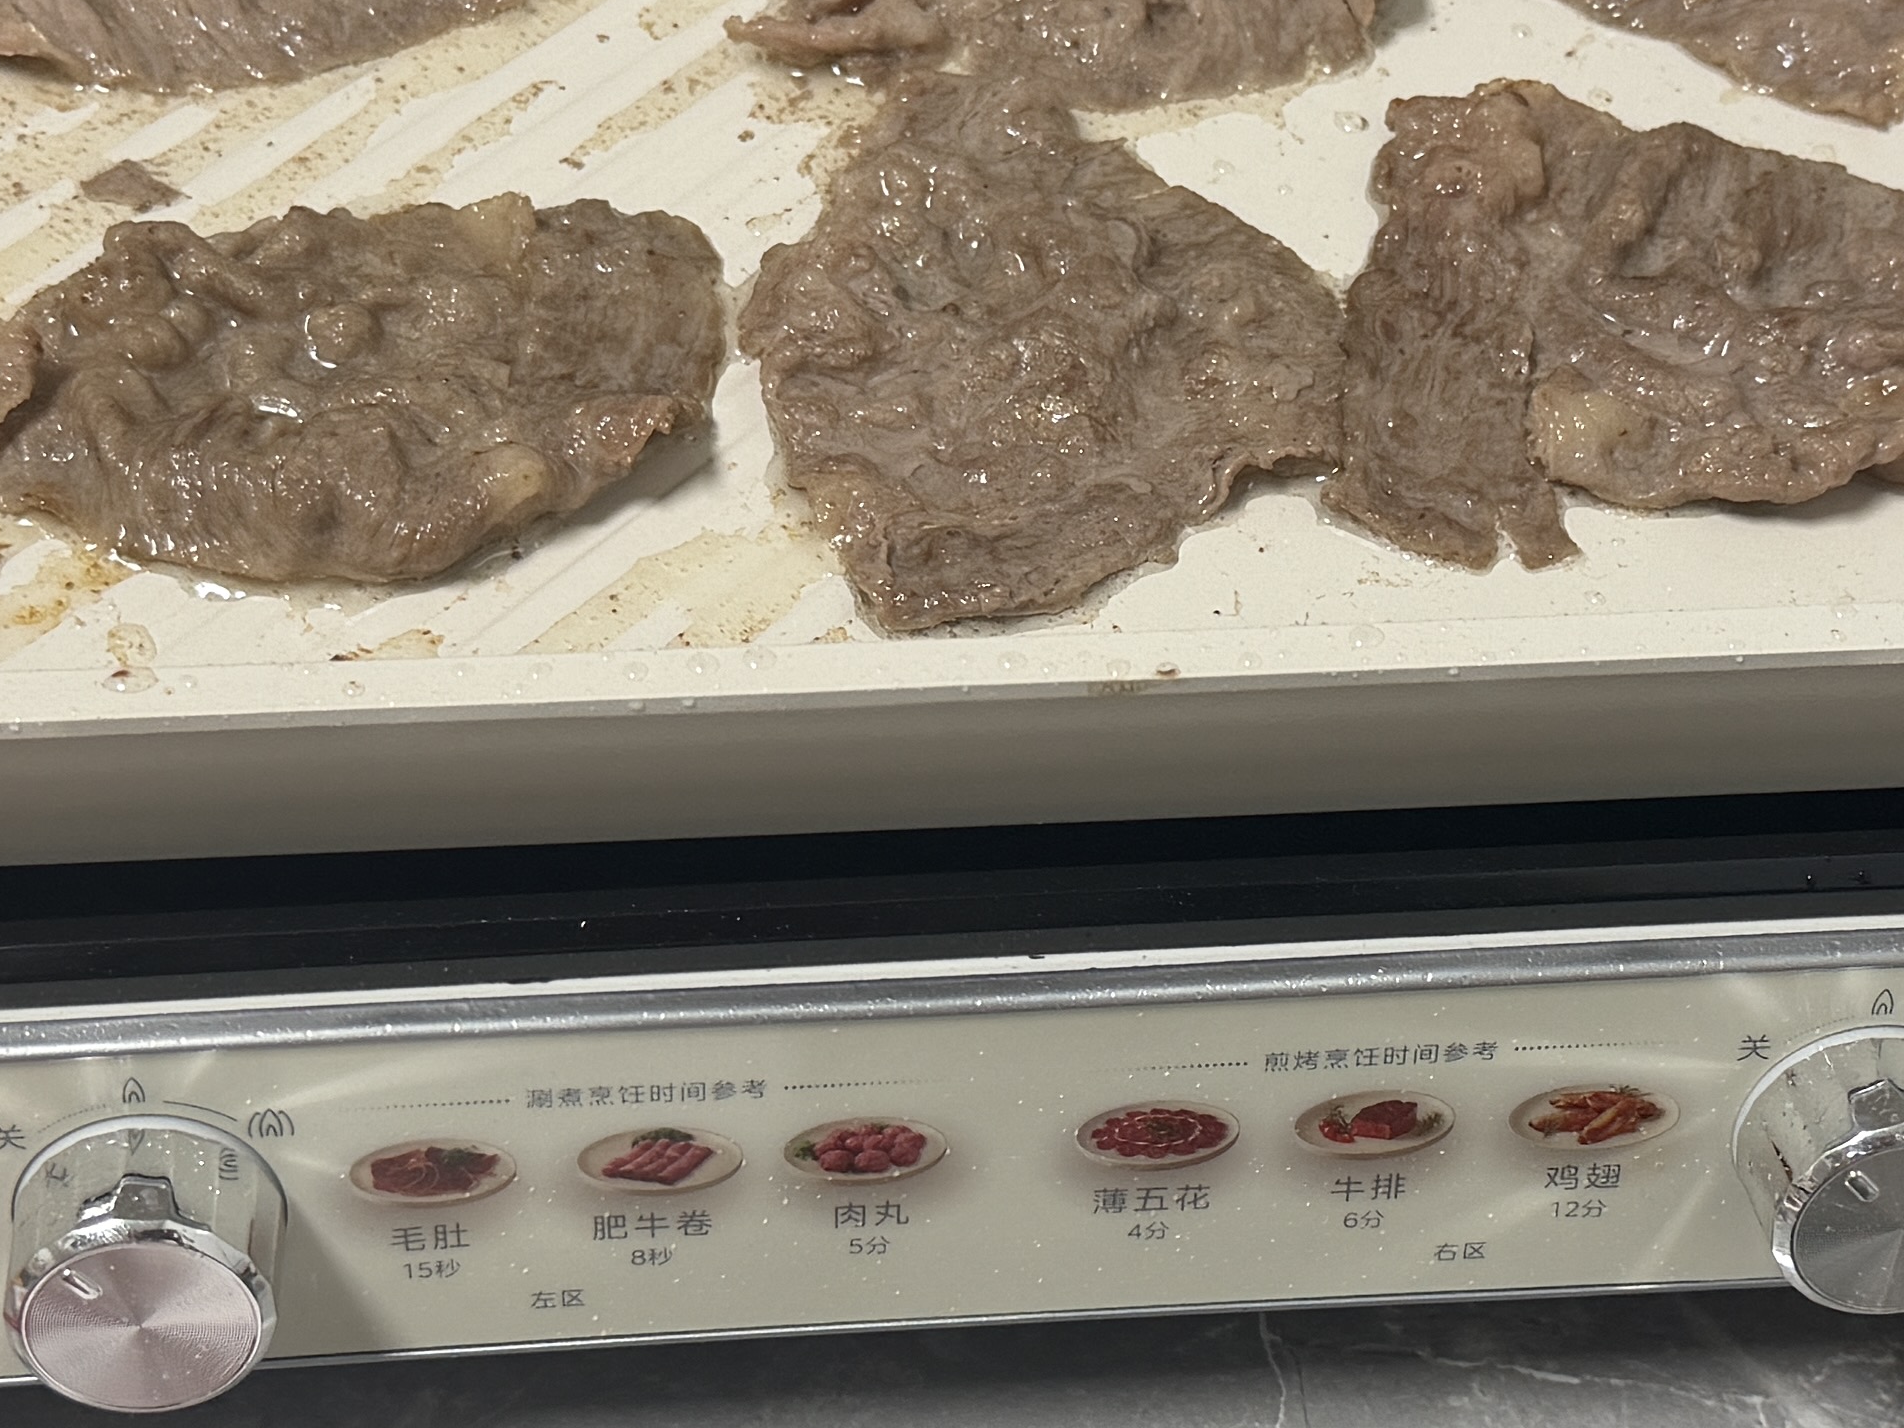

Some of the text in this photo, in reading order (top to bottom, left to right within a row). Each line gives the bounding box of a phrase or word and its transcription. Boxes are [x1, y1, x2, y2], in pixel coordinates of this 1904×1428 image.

[1263, 1039, 1501, 1074] 煎烤烹饪时间参考
[1737, 1033, 1771, 1061] 关
[524, 1077, 770, 1111] 涮煮烹饪时间参考
[1331, 1171, 1407, 1204] 牛排
[1545, 1162, 1623, 1194] 鸡翅
[1092, 1183, 1212, 1216] 薄五花
[1550, 1196, 1609, 1219] 12分
[591, 1209, 714, 1243] 肥牛卷
[833, 1199, 911, 1231] 肉丸
[1342, 1207, 1386, 1230] 6分
[389, 1220, 471, 1253] 毛肚
[1126, 1218, 1170, 1242] 4分
[629, 1244, 674, 1270] 8秒
[848, 1234, 892, 1259] 5分
[1433, 1240, 1489, 1263] 右区
[400, 1255, 462, 1282] 15秒
[530, 1287, 587, 1310] 左区
